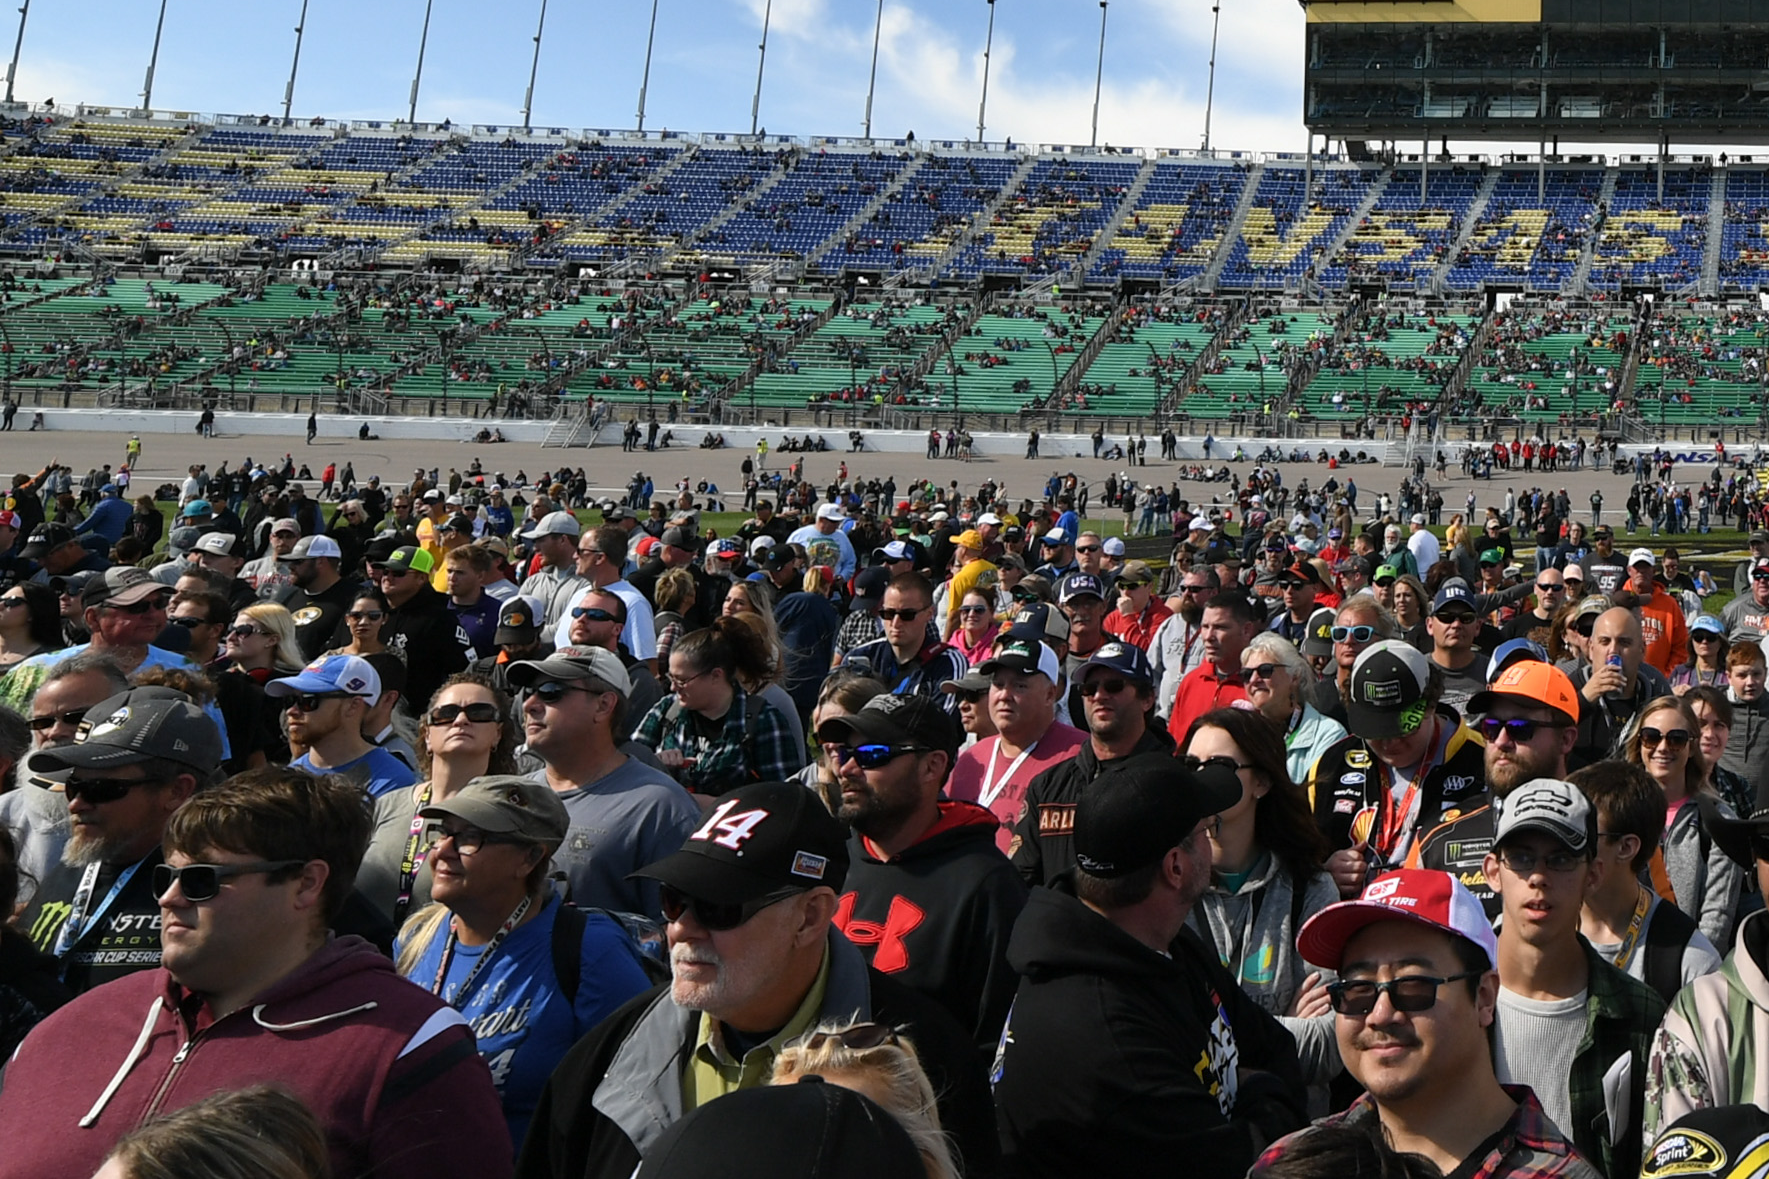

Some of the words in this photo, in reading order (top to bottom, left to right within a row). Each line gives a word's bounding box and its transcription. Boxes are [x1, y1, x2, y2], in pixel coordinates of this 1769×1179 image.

[1070, 575, 1096, 589] USA
[1599, 576, 1616, 589] 95
[1445, 587, 1466, 598] LITE
[1316, 624, 1331, 638] 48
[346, 678, 366, 691] 9
[1514, 804, 1569, 818] CHEVROLET
[690, 797, 770, 851] 14
[1389, 896, 1418, 907] TIRE
[101, 936, 158, 946] ERGY
[104, 951, 128, 963] CUP
[1655, 1147, 1688, 1166] Sprint
